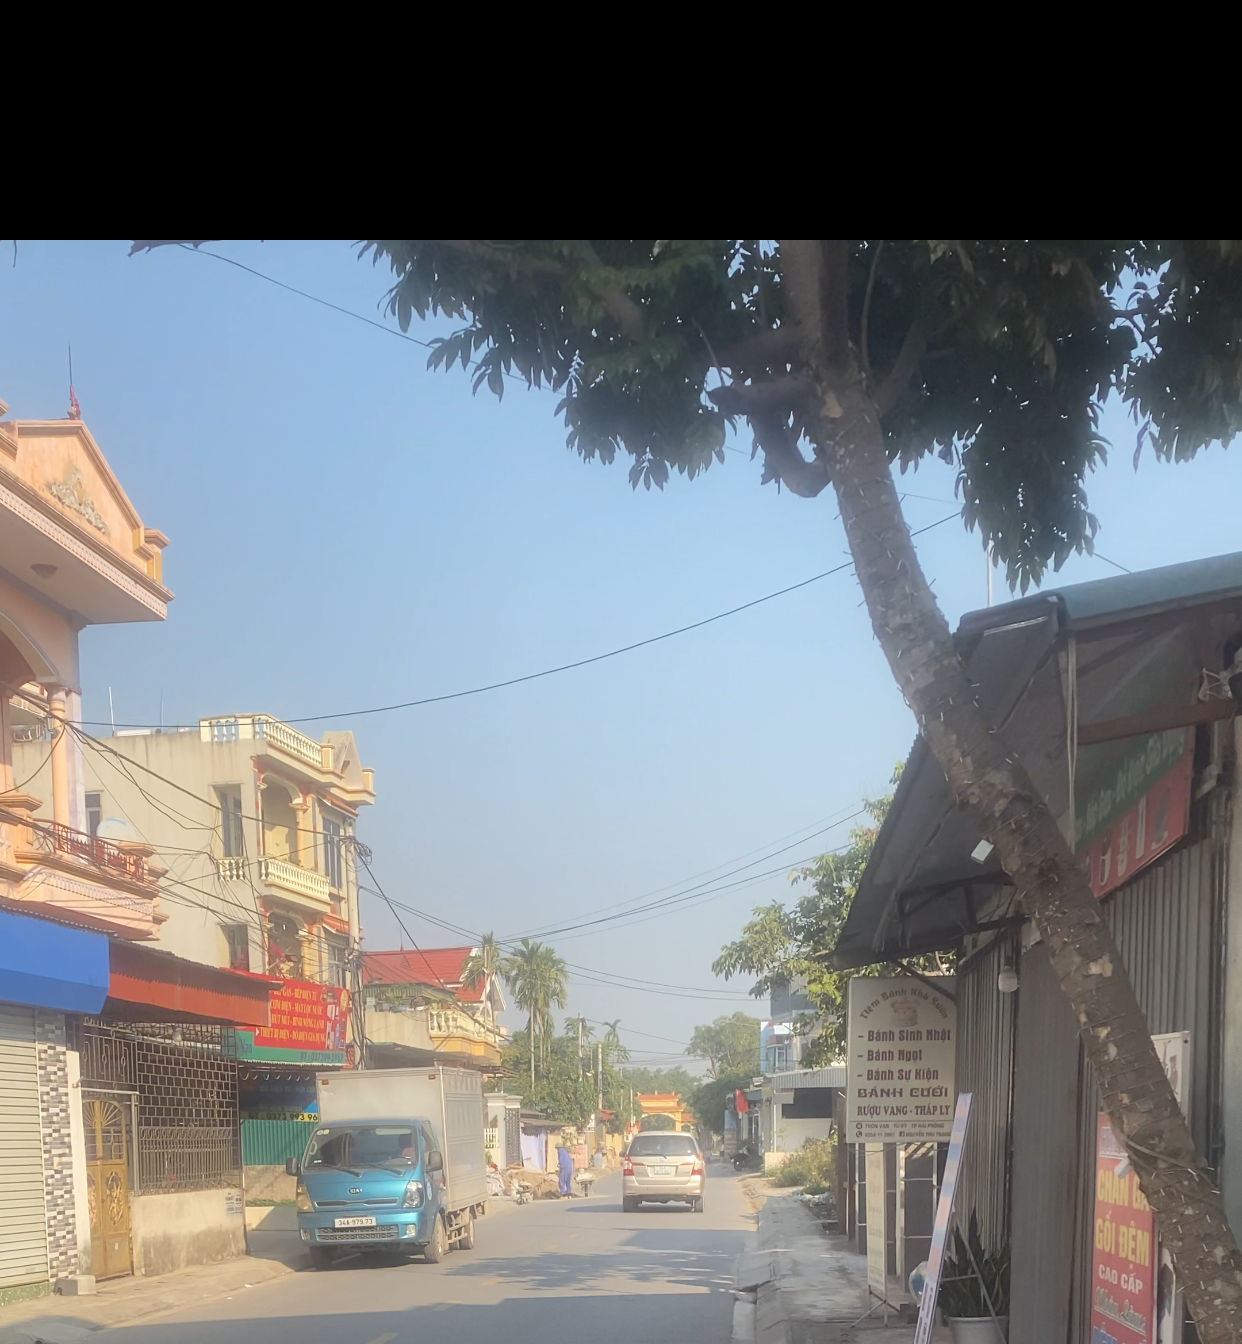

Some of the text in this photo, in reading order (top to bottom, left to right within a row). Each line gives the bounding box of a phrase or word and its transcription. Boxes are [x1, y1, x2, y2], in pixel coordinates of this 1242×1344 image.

[880, 988, 907, 1001] Bánh
[868, 1029, 951, 1043] Bánh Sinh Nhật
[867, 1049, 922, 1063] Bánh Ngọt
[867, 1068, 938, 1083] Bánh Sự Kiện
[858, 1086, 948, 1098] BÁNH CƯỚI
[858, 1104, 950, 1118] RƯỢU VANG THÁP LY
[1095, 1210, 1149, 1269] GỐI ĐỆM
[1099, 1264, 1143, 1295] CAO CẤP
